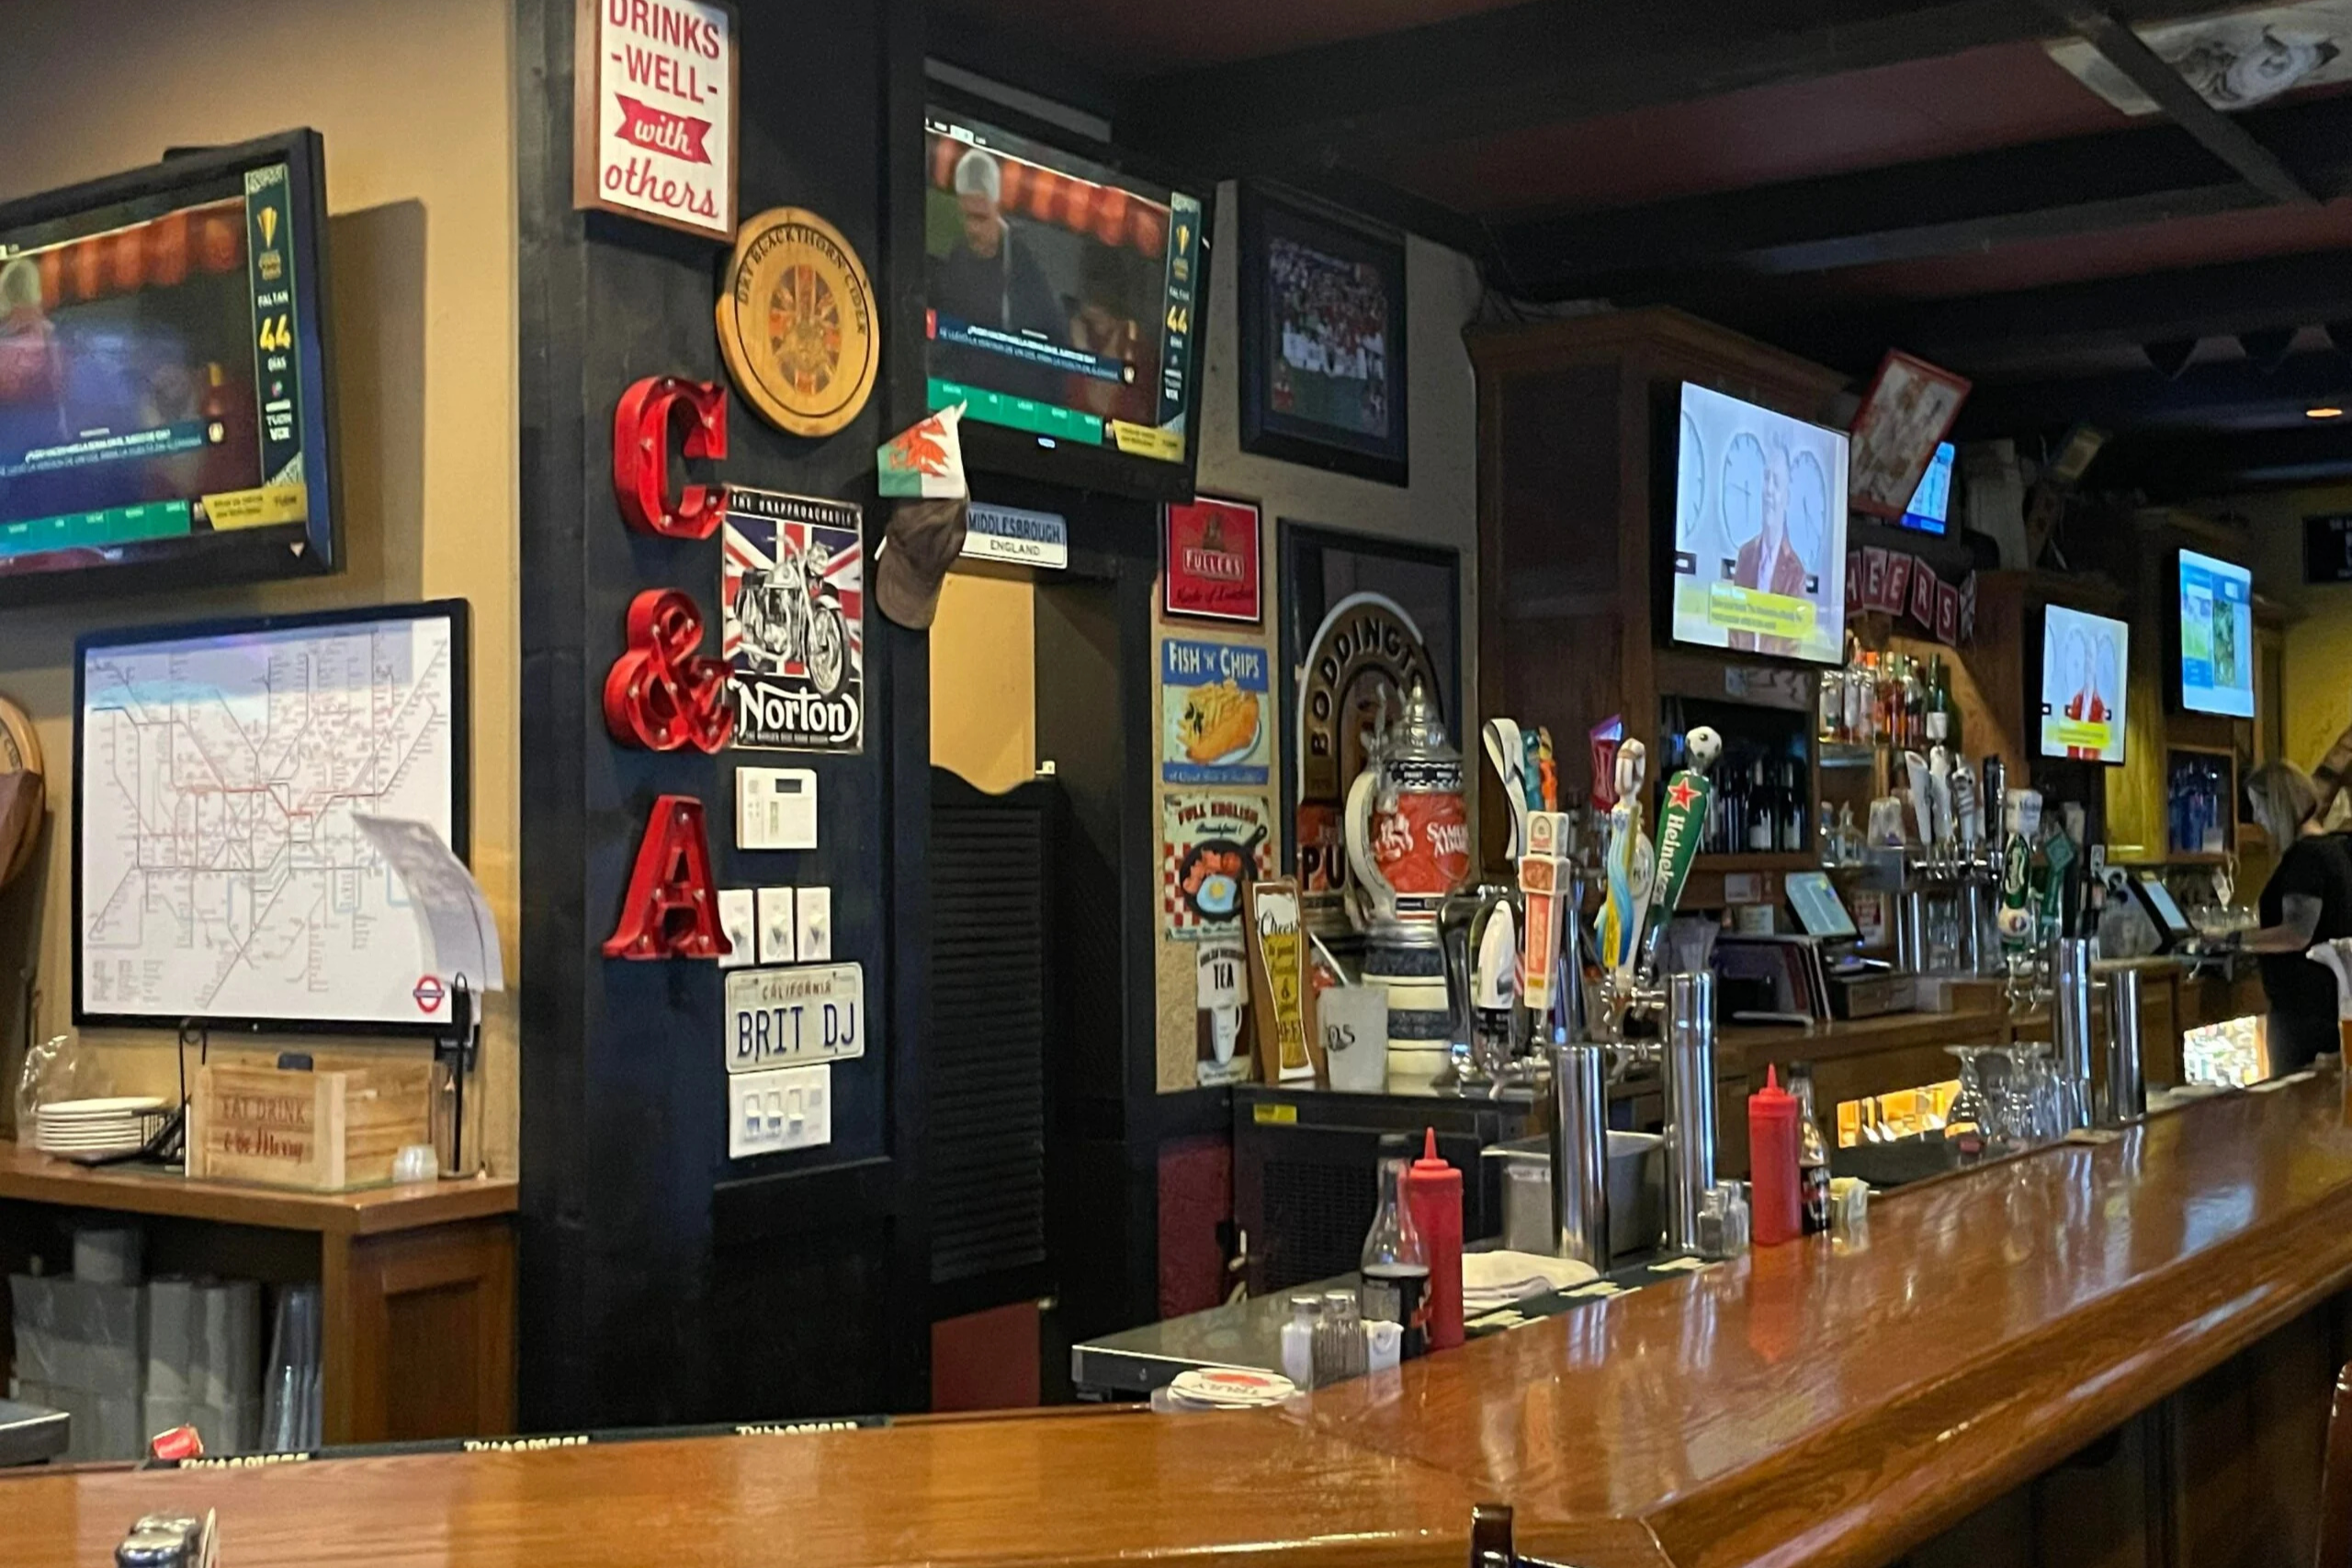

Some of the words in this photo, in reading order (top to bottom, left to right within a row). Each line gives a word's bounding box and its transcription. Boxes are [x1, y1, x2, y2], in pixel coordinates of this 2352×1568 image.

[609, 0, 720, 60] DRINKS
[634, 114, 694, 156] with
[604, 157, 718, 219] others
[737, 263, 754, 307] DRY
[752, 228, 846, 269] BLACKTHORN
[844, 274, 866, 335] CIDER
[259, 314, 291, 351] 44
[1167, 304, 1188, 335] 44
[967, 511, 1061, 544] MIDDLESBROUGH
[989, 539, 1041, 556] ENGLAND
[1169, 641, 1201, 675] FISH
[1220, 646, 1260, 680] CHIPS
[1310, 615, 1430, 756] BODDINGTO
[727, 678, 860, 742] Norton
[762, 979, 832, 1001] CALIFORNIA
[1214, 963, 1235, 990] TEA
[737, 1006, 804, 1059] BRIT
[823, 1002, 854, 1047] DJ
